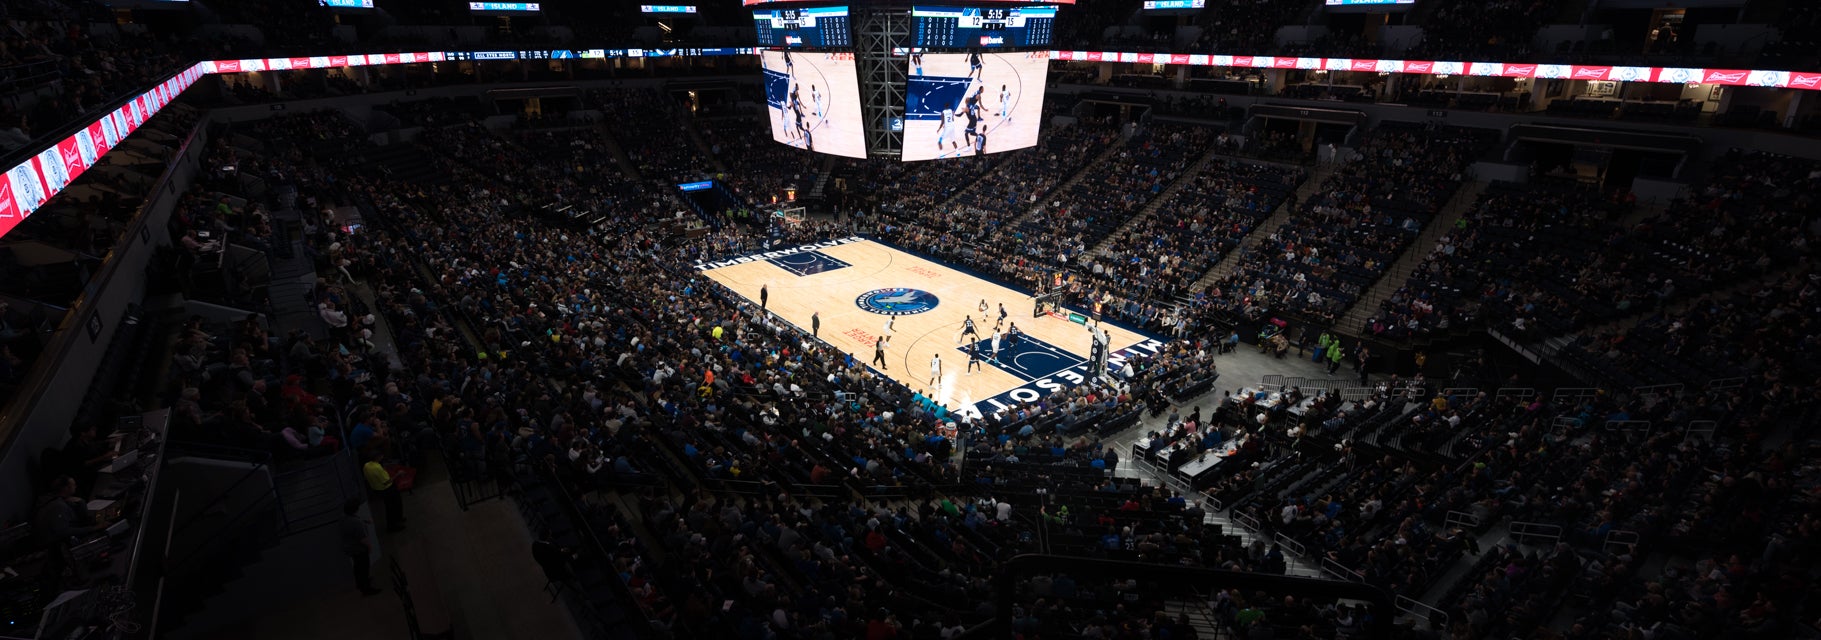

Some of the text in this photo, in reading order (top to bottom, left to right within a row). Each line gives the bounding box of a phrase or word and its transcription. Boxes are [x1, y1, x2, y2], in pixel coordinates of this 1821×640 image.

[988, 9, 1003, 19] 5:15
[972, 17, 980, 26] 12
[1008, 18, 1014, 26] 15
[693, 236, 865, 271] TIMBERWOLVES
[954, 339, 1164, 421] MINESOTA
